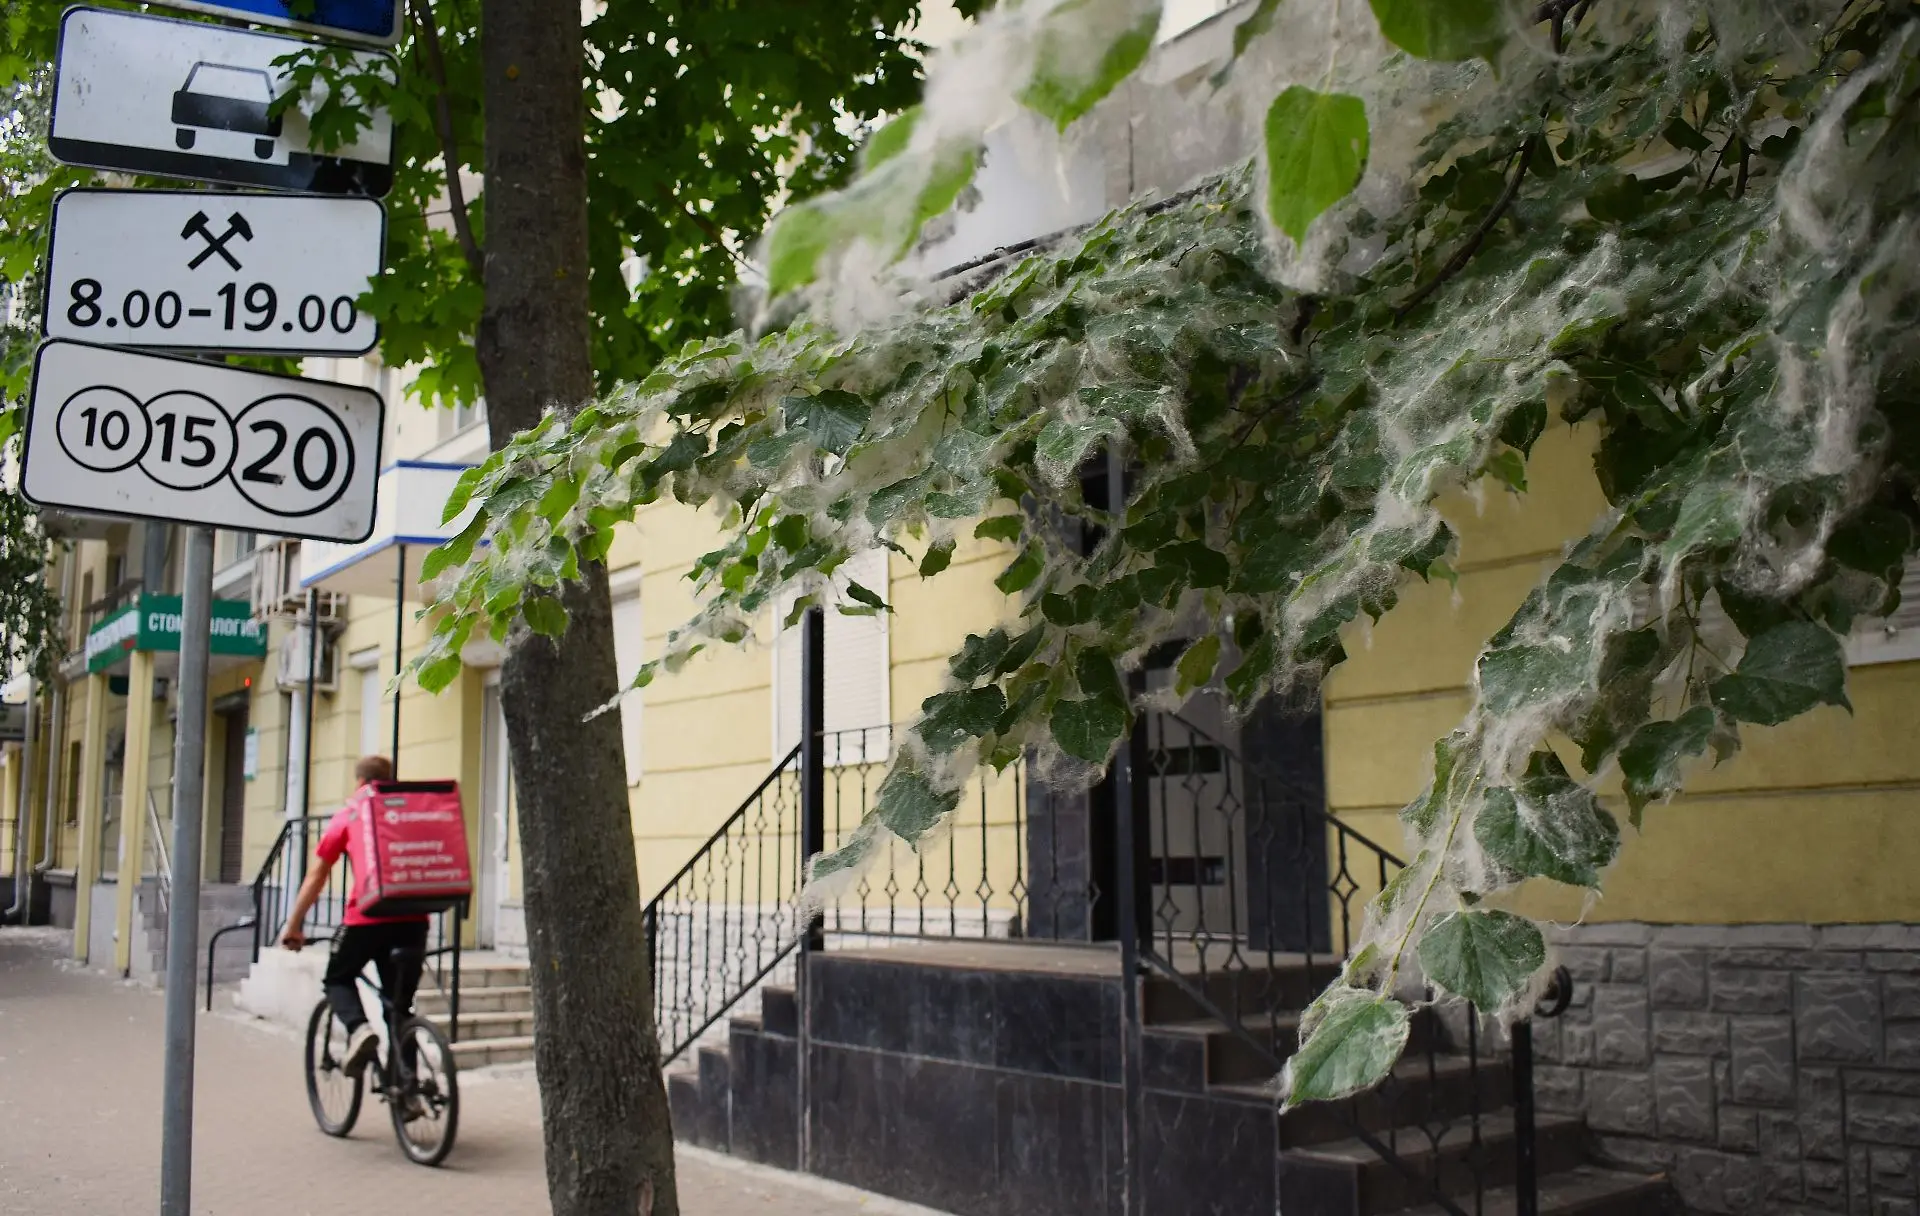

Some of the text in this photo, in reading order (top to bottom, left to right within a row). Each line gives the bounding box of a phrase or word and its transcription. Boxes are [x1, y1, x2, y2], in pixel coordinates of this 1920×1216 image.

[80, 407, 337, 491] 10 15 20
